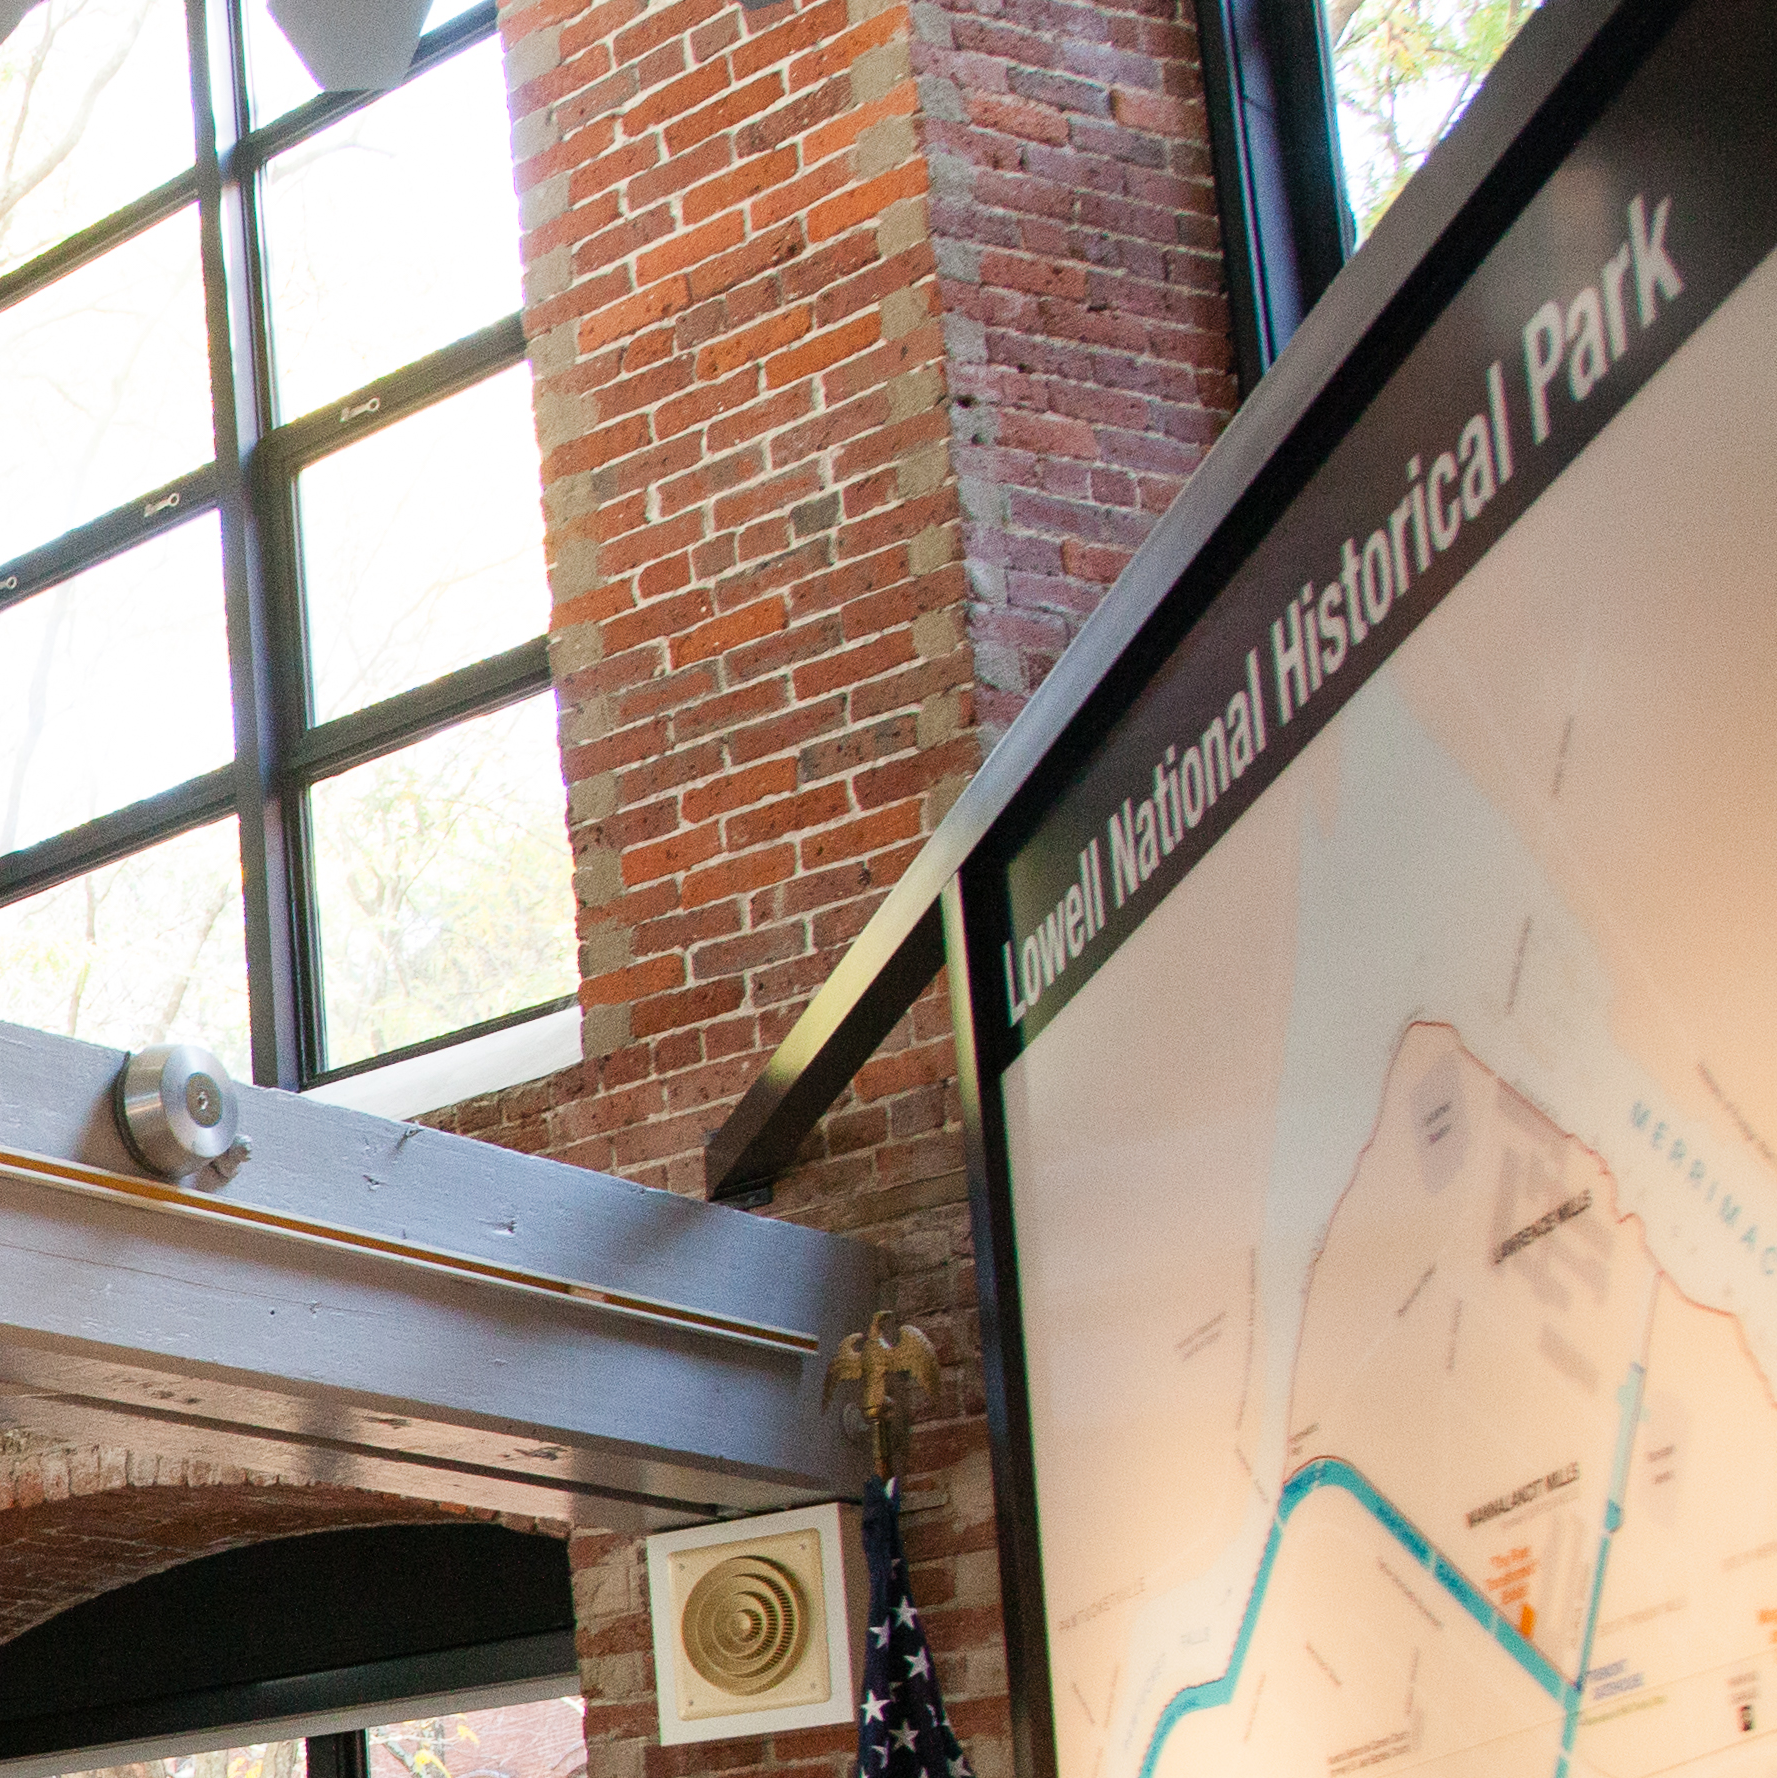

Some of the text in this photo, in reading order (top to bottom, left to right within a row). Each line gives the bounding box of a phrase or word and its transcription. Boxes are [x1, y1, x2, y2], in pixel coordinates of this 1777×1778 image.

[1002, 194, 1688, 1027] Lowell National Historical Park
